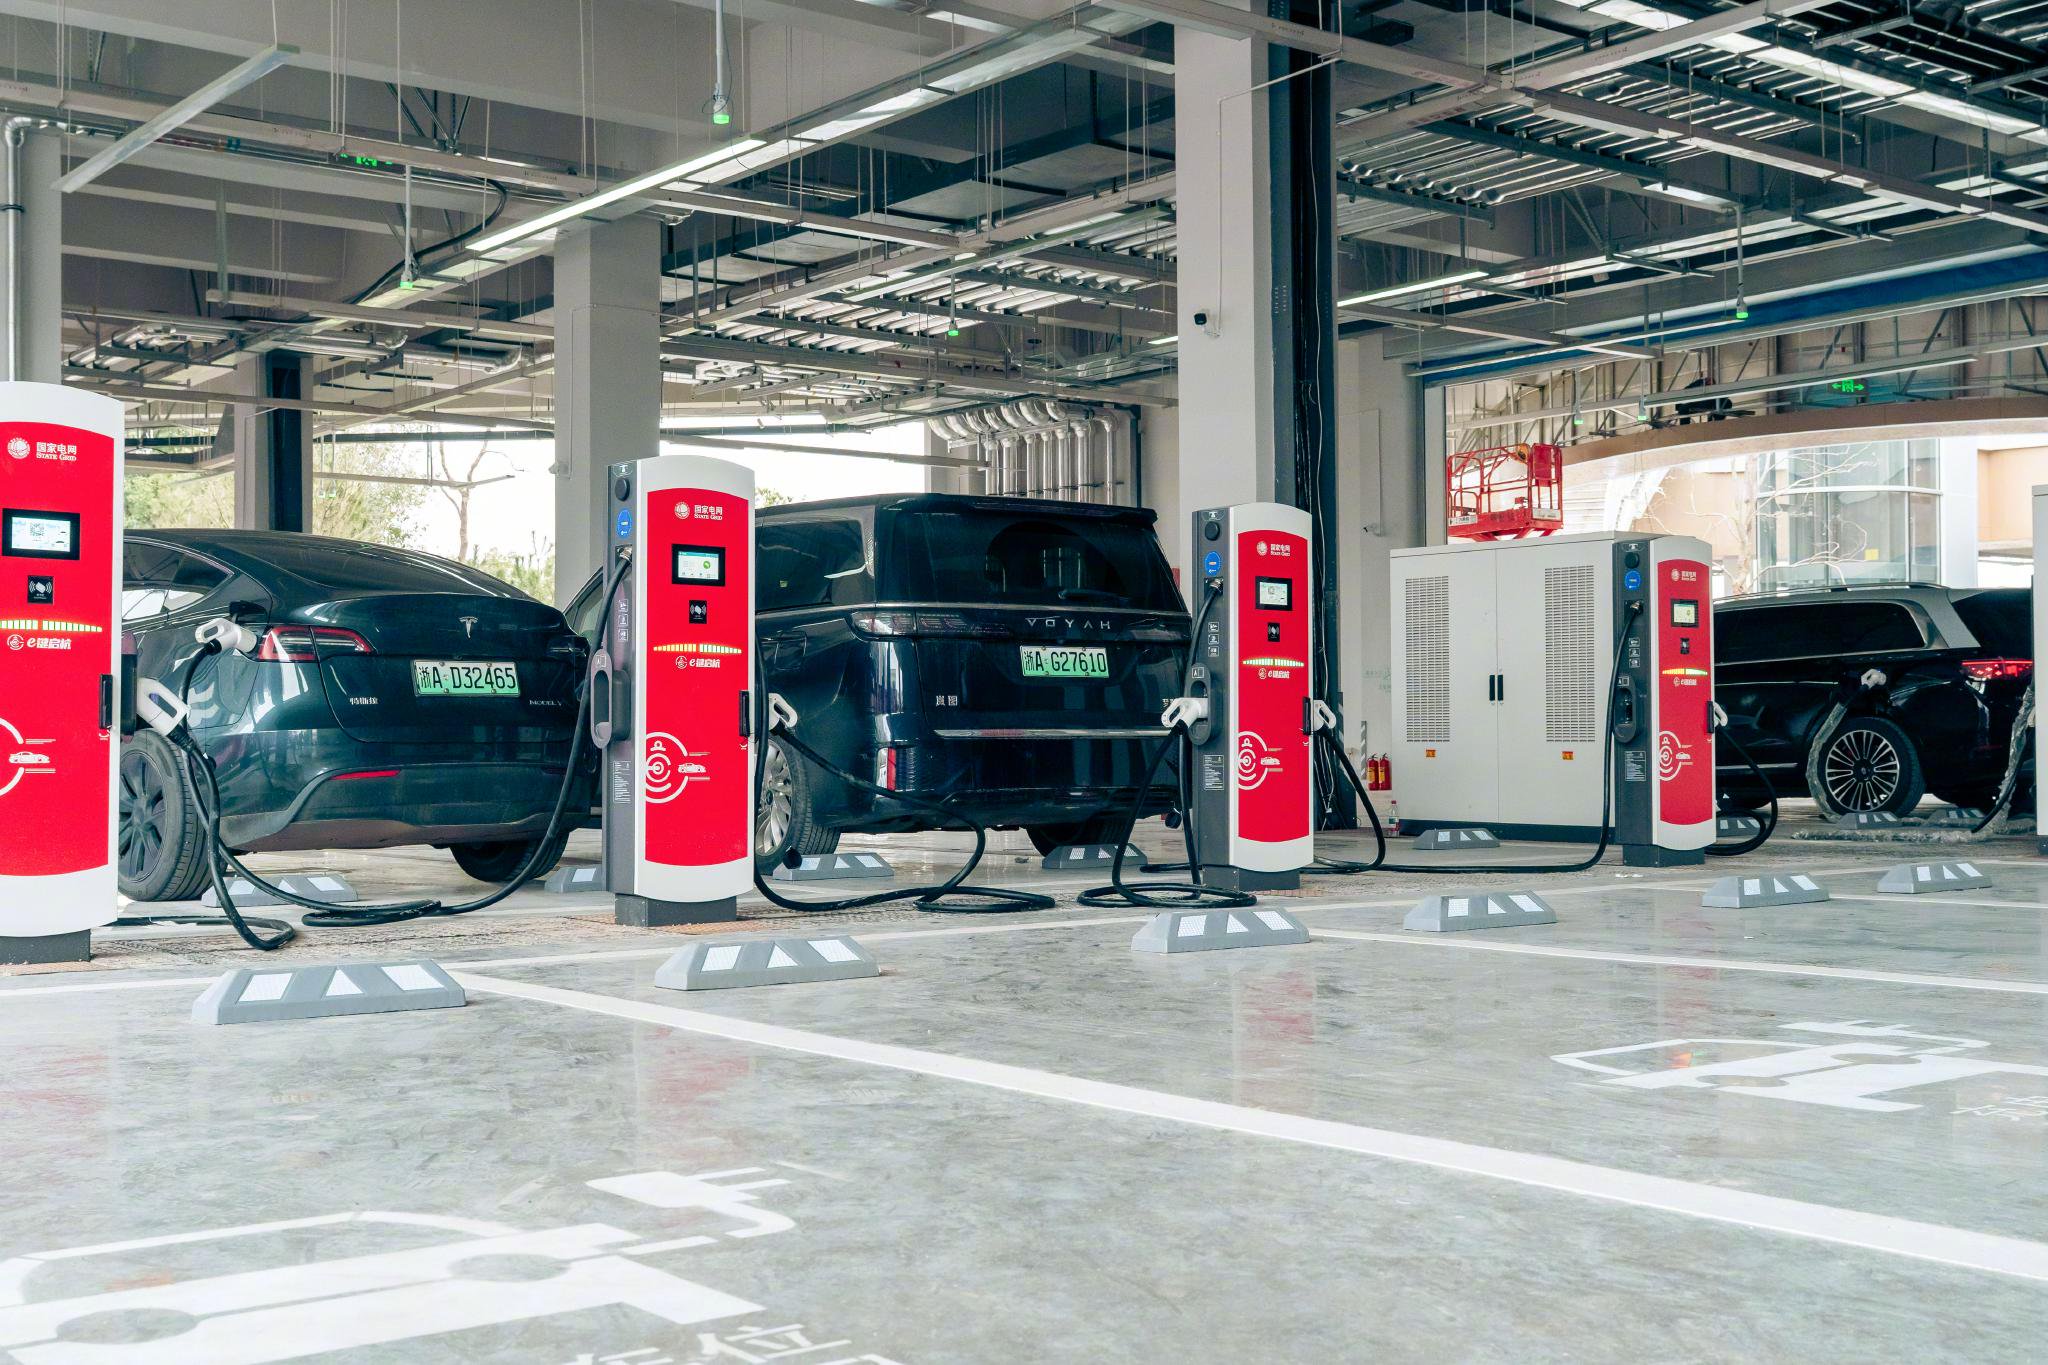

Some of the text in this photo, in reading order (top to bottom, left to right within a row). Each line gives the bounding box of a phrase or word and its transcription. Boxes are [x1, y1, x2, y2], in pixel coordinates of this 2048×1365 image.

[37, 442, 77, 454] 国家电网
[694, 504, 723, 515] 国家电网
[1027, 618, 1111, 630] VOYAH
